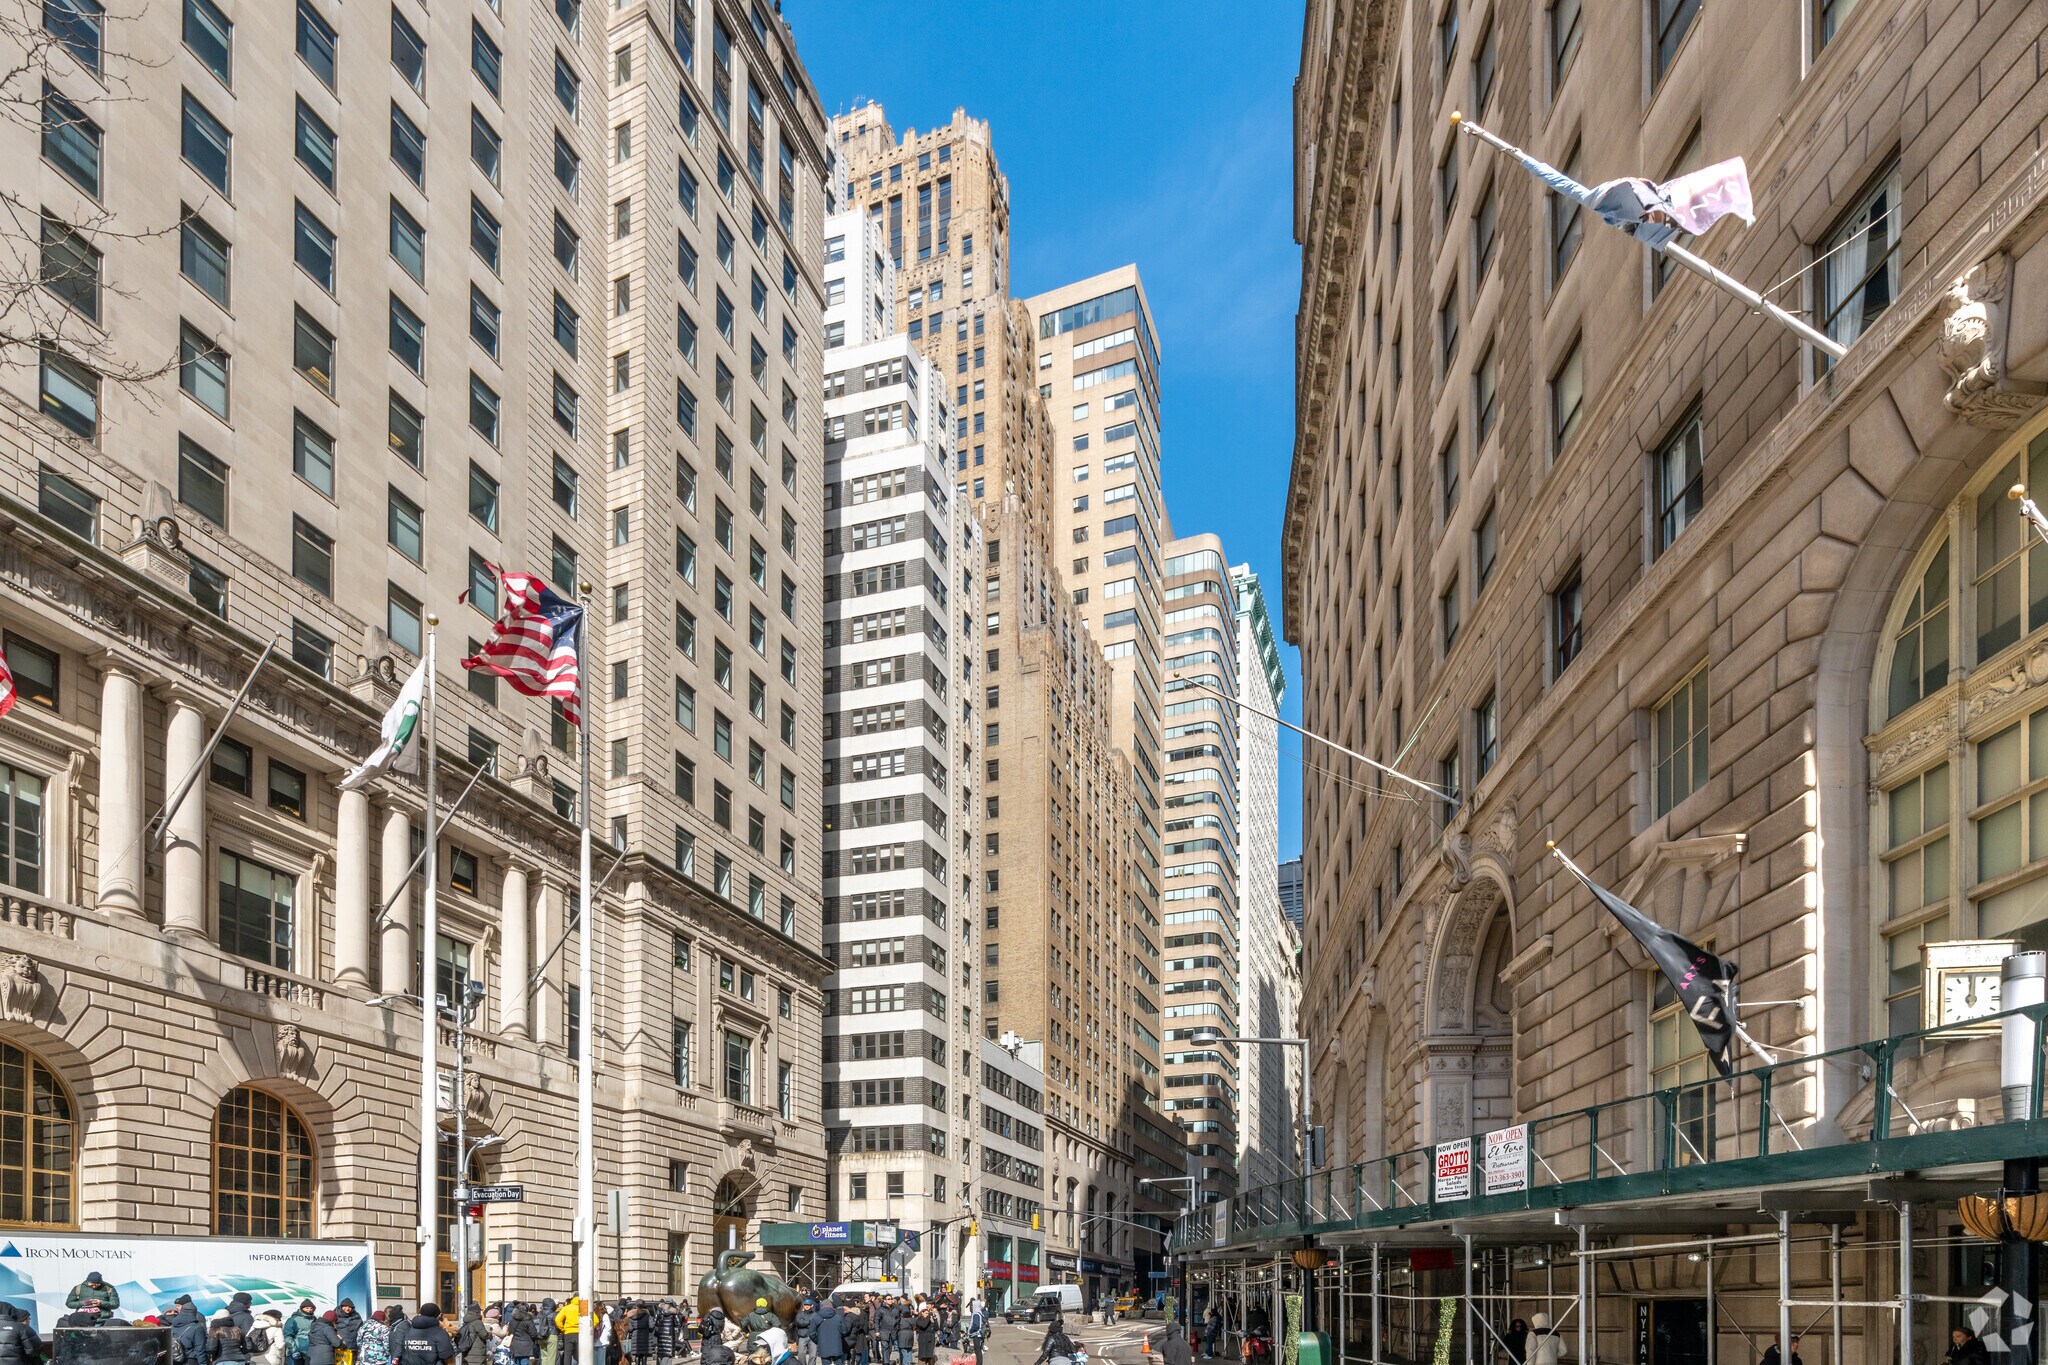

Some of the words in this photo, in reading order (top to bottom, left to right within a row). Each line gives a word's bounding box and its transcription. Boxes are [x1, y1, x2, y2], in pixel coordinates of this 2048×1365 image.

[94, 954, 303, 1023] CUNARD
[1488, 1131, 1503, 1144] NOW
[1505, 1127, 1523, 1140] OPEN
[1437, 1144, 1452, 1153] NOW
[1453, 1140, 1470, 1150] OPEN!
[1487, 1145, 1500, 1159] El
[1438, 1150, 1469, 1168] GROTTO
[1440, 1166, 1467, 1177] Pizza
[473, 1190, 507, 1198] Evacuation
[507, 1190, 520, 1199] Day
[822, 1225, 843, 1234] planet
[25, 1247, 60, 1258] IRON
[62, 1248, 133, 1259] MOUNTAIN
[249, 1254, 311, 1262] INFORMATION
[312, 1255, 353, 1263] MANAGED
